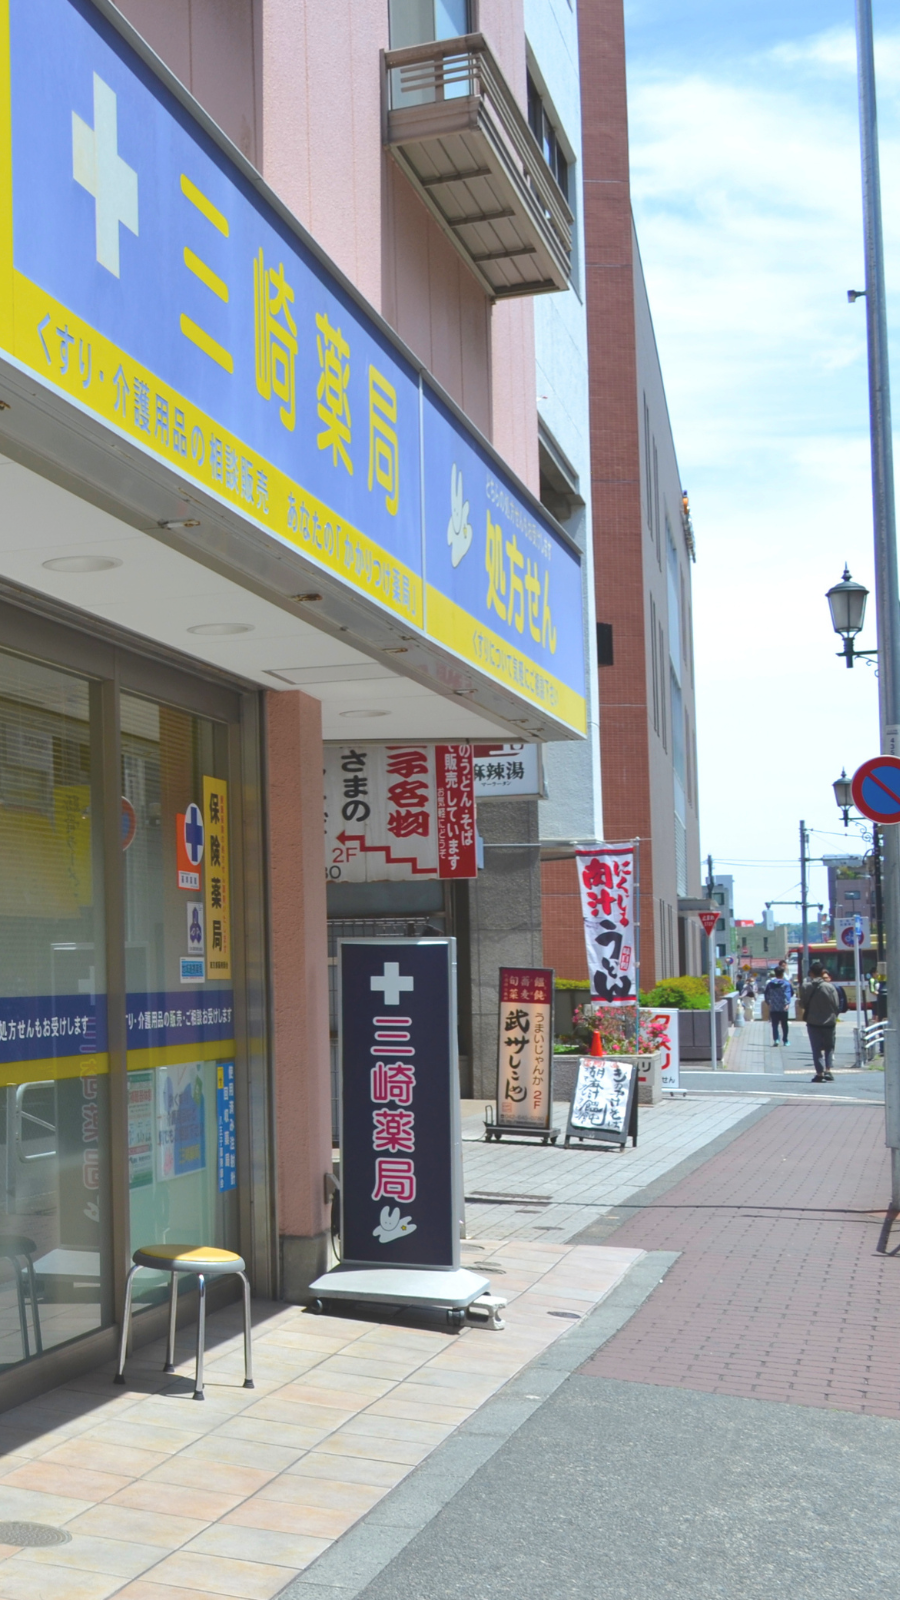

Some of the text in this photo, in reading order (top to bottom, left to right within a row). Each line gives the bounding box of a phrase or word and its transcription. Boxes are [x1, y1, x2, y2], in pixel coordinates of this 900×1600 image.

[180, 173, 399, 516] 三崎薬局
[36, 312, 270, 514] くすり・介護用品の相談販売
[485, 508, 557, 655] 処方せん
[332, 847, 358, 863] 2F
[459, 745, 473, 846] のうどん・そば
[208, 793, 222, 952] 保険薬局
[0, 1014, 89, 1041] 処方せんもお受けします
[125, 1007, 233, 1031] り・介護用品の販売・ご相談お受けします
[532, 1012, 545, 1110] うまいじゃんか 2F
[370, 1016, 416, 1203] 三崎薬局
